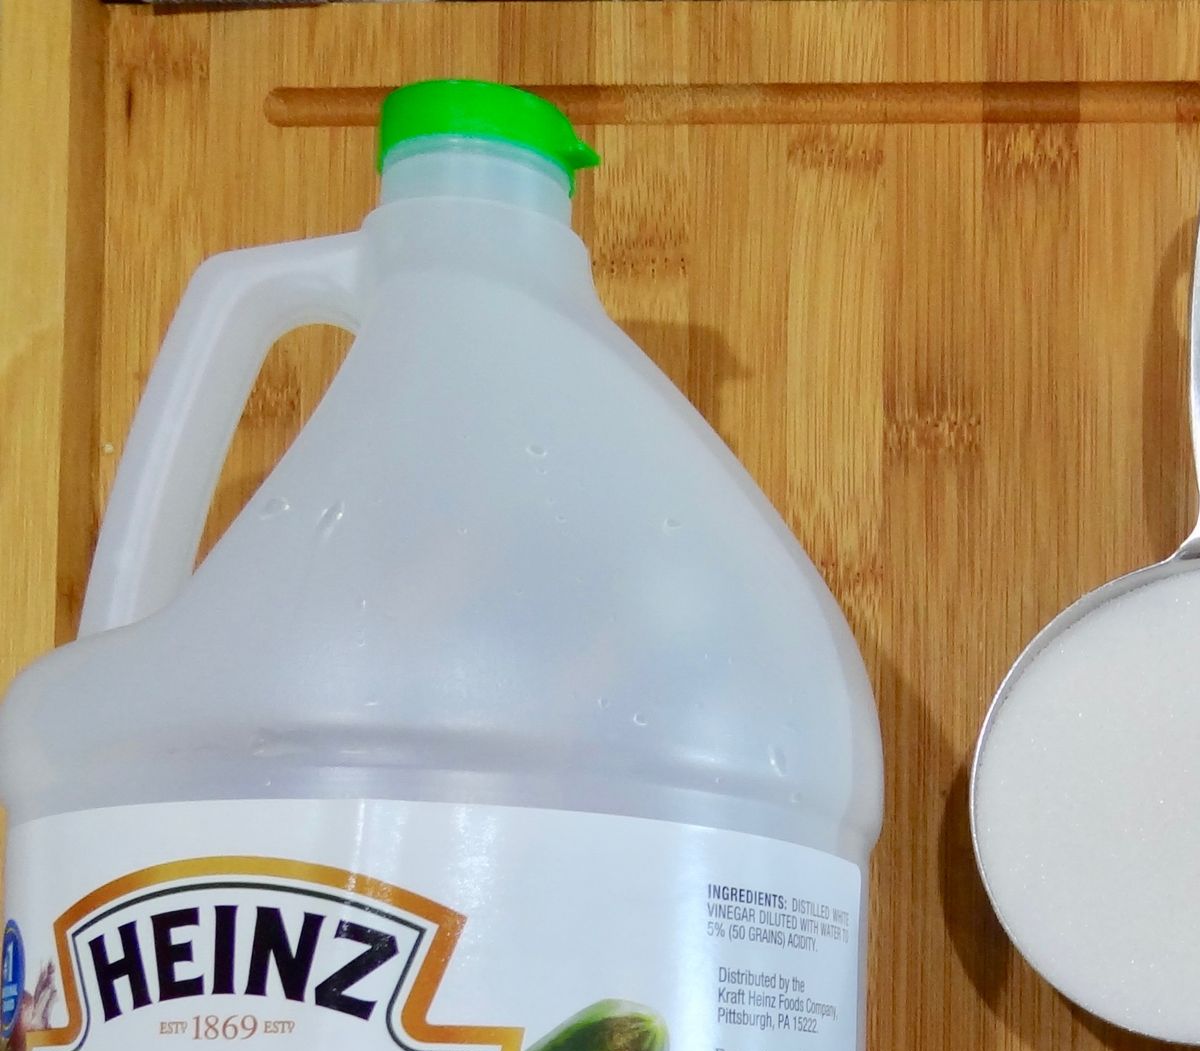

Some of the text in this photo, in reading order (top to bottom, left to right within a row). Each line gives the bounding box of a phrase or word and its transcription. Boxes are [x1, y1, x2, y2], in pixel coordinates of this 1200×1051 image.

[707, 883, 788, 911] INGREDIENTS:
[792, 897, 830, 920] DISTILLED
[706, 903, 756, 924] VINEGAR
[759, 910, 798, 931] DILUTED
[800, 917, 819, 936] WITH
[706, 921, 726, 938] 5%
[728, 924, 746, 943] (50
[748, 926, 786, 950] GRAINS)
[87, 904, 400, 1023] HEINZ
[718, 966, 805, 994] Distributed by the
[717, 987, 745, 1006] Kraft
[748, 990, 776, 1009] Heinz
[778, 994, 804, 1012] Foods
[192, 1014, 258, 1040] 1869
[717, 1006, 775, 1031] Pittsburgh,
[777, 1013, 790, 1030] PA
